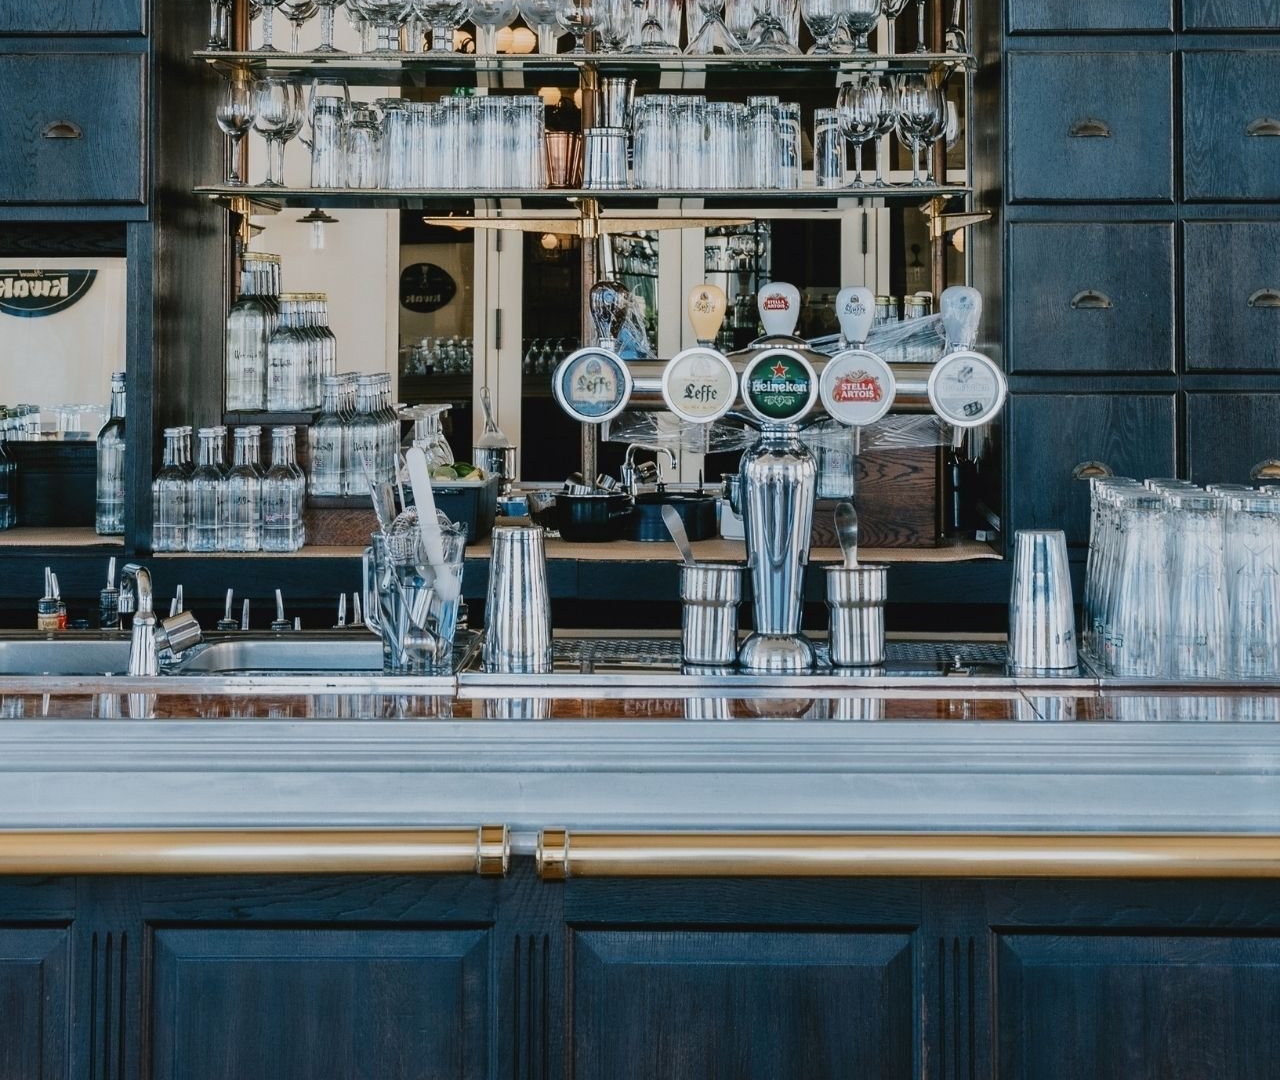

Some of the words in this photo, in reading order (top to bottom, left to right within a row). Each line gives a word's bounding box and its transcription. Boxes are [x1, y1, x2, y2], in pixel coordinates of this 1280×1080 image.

[576, 375, 612, 395] Leffe
[684, 383, 718, 403] Leffe
[751, 380, 808, 394] Heineken
[841, 390, 874, 398] ARTOIS
